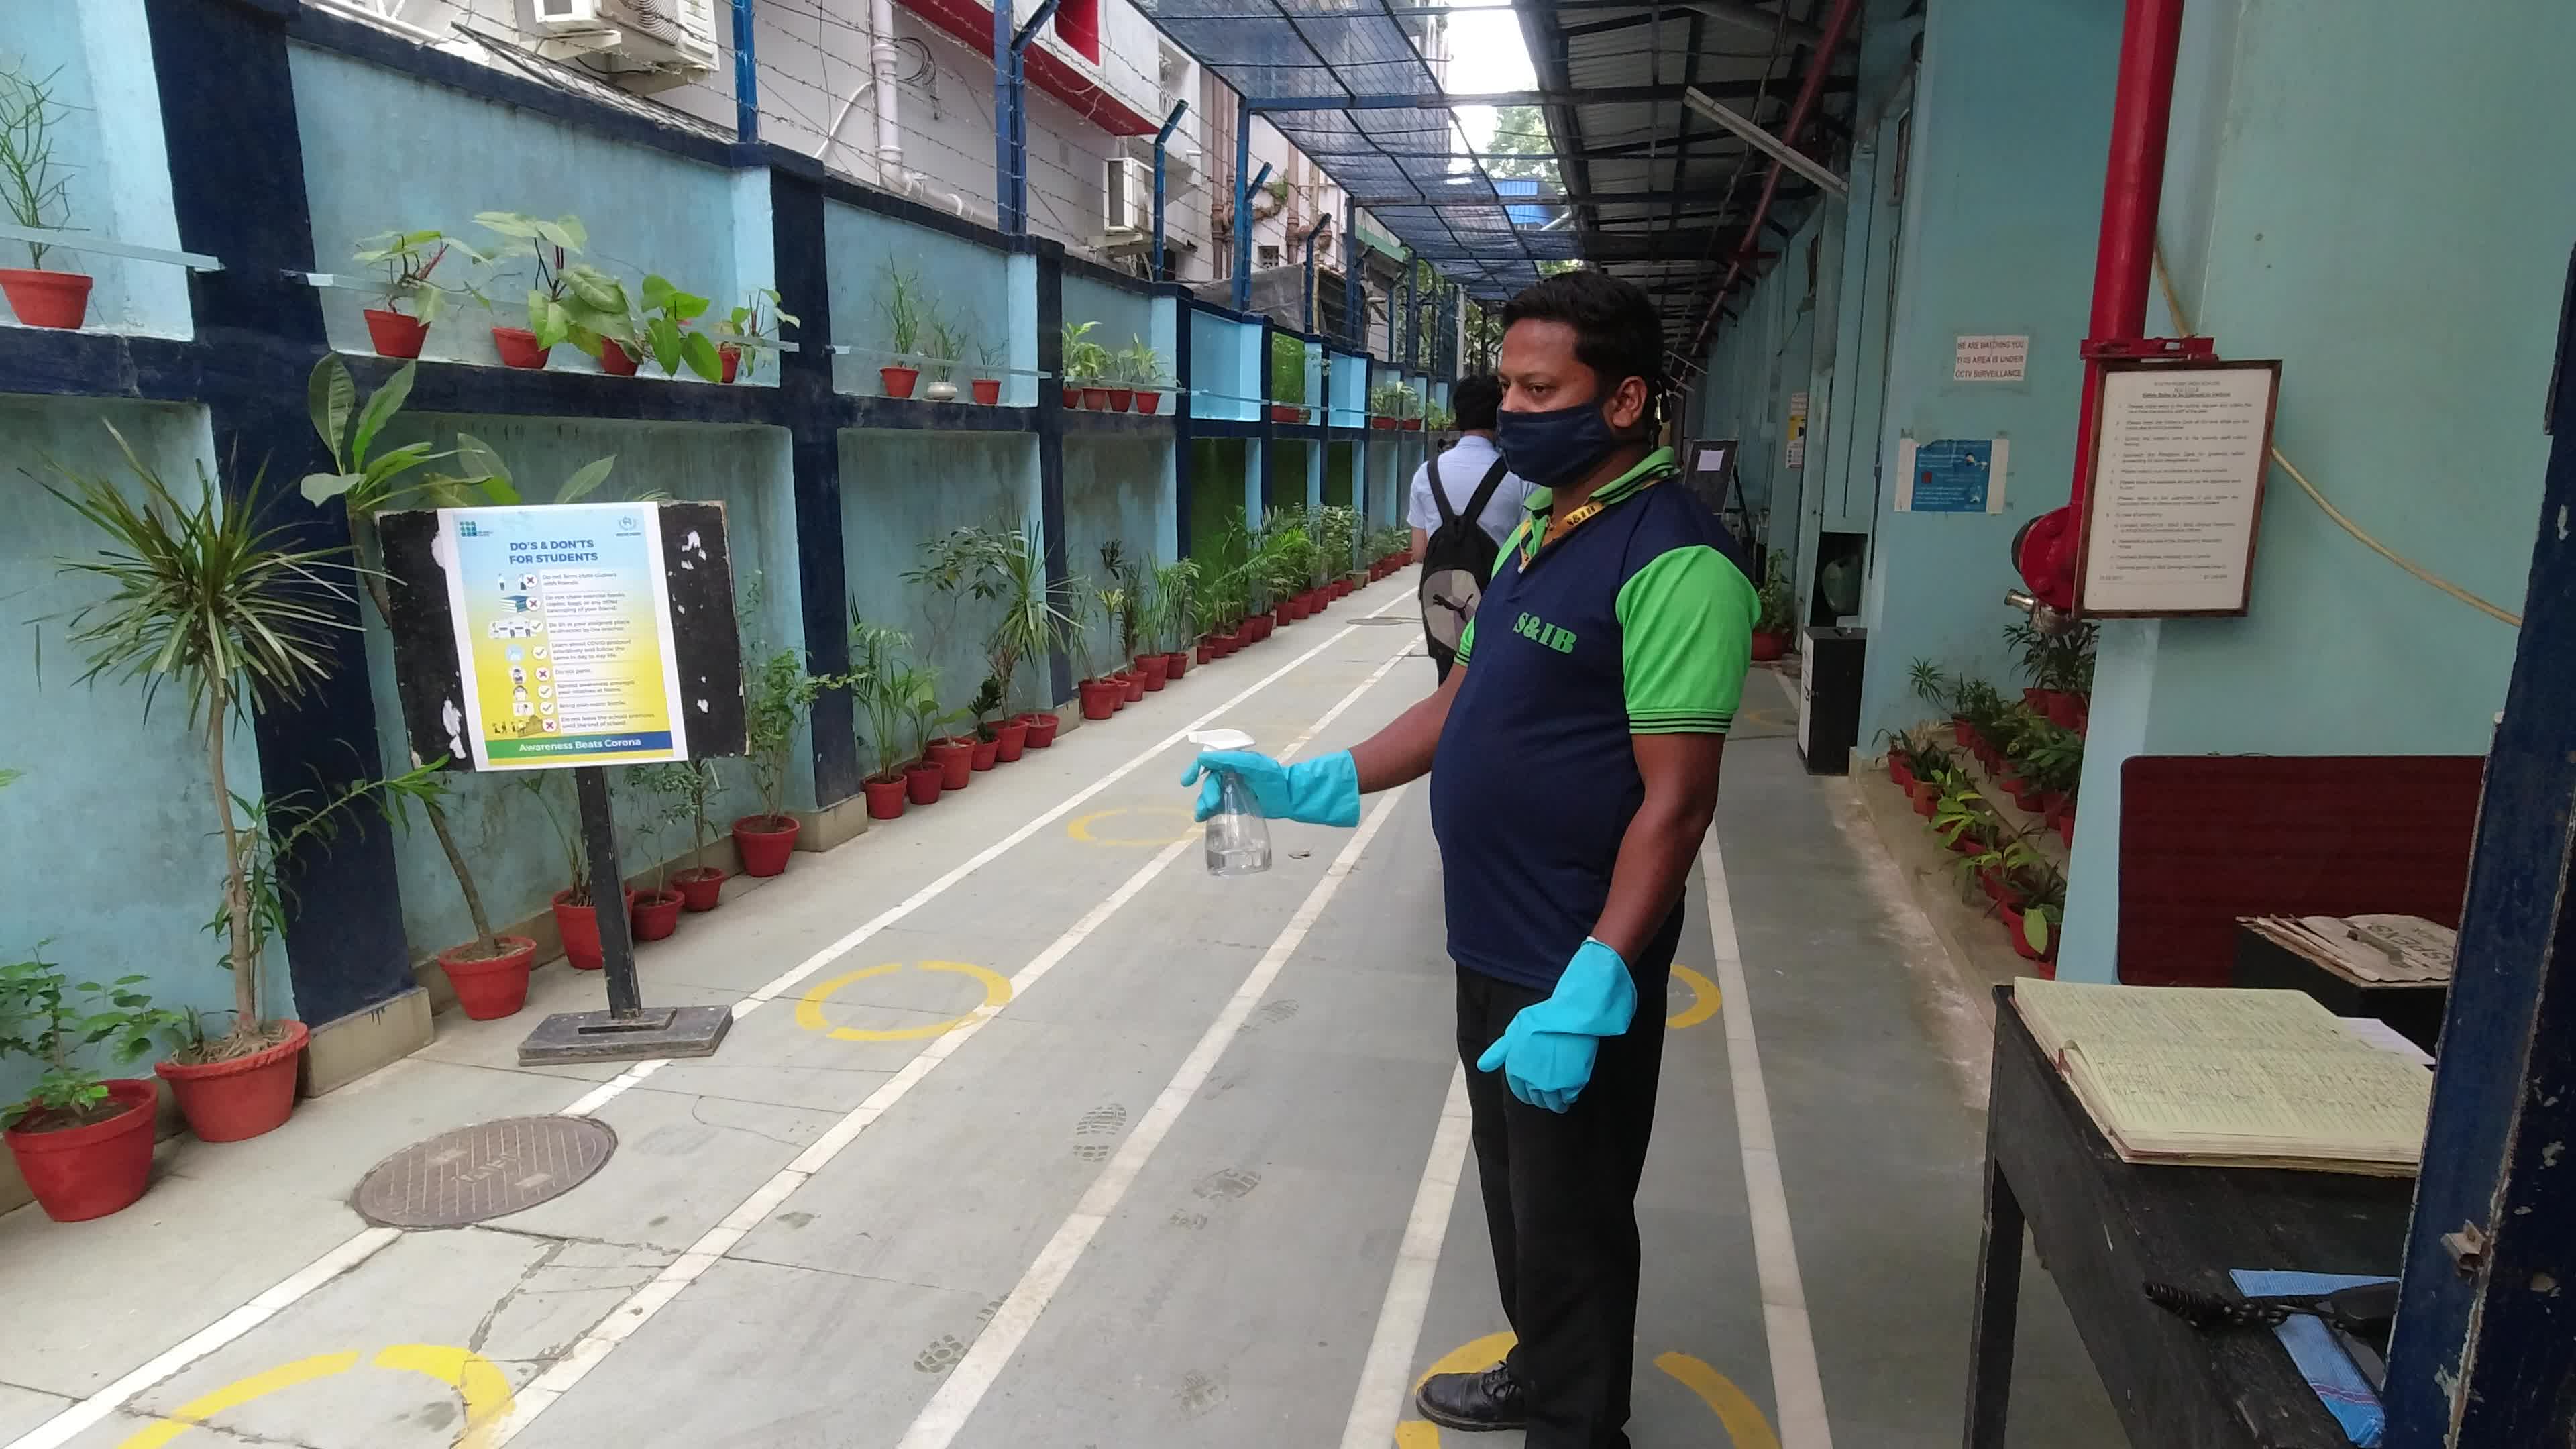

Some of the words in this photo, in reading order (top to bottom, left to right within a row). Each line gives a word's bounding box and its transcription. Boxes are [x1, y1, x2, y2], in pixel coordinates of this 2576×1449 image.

[2012, 341, 2024, 349] YOU
[2000, 355, 2024, 363] UNDER
[510, 541, 537, 551] DO'S
[541, 541, 548, 549] &
[551, 539, 594, 549] DON'TS
[510, 555, 533, 564] FOR
[536, 553, 598, 563] STUDENTS
[1513, 612, 1578, 654] S&IB
[519, 743, 573, 752] Awareness
[575, 741, 602, 749] Beats
[605, 739, 641, 747] Corona
